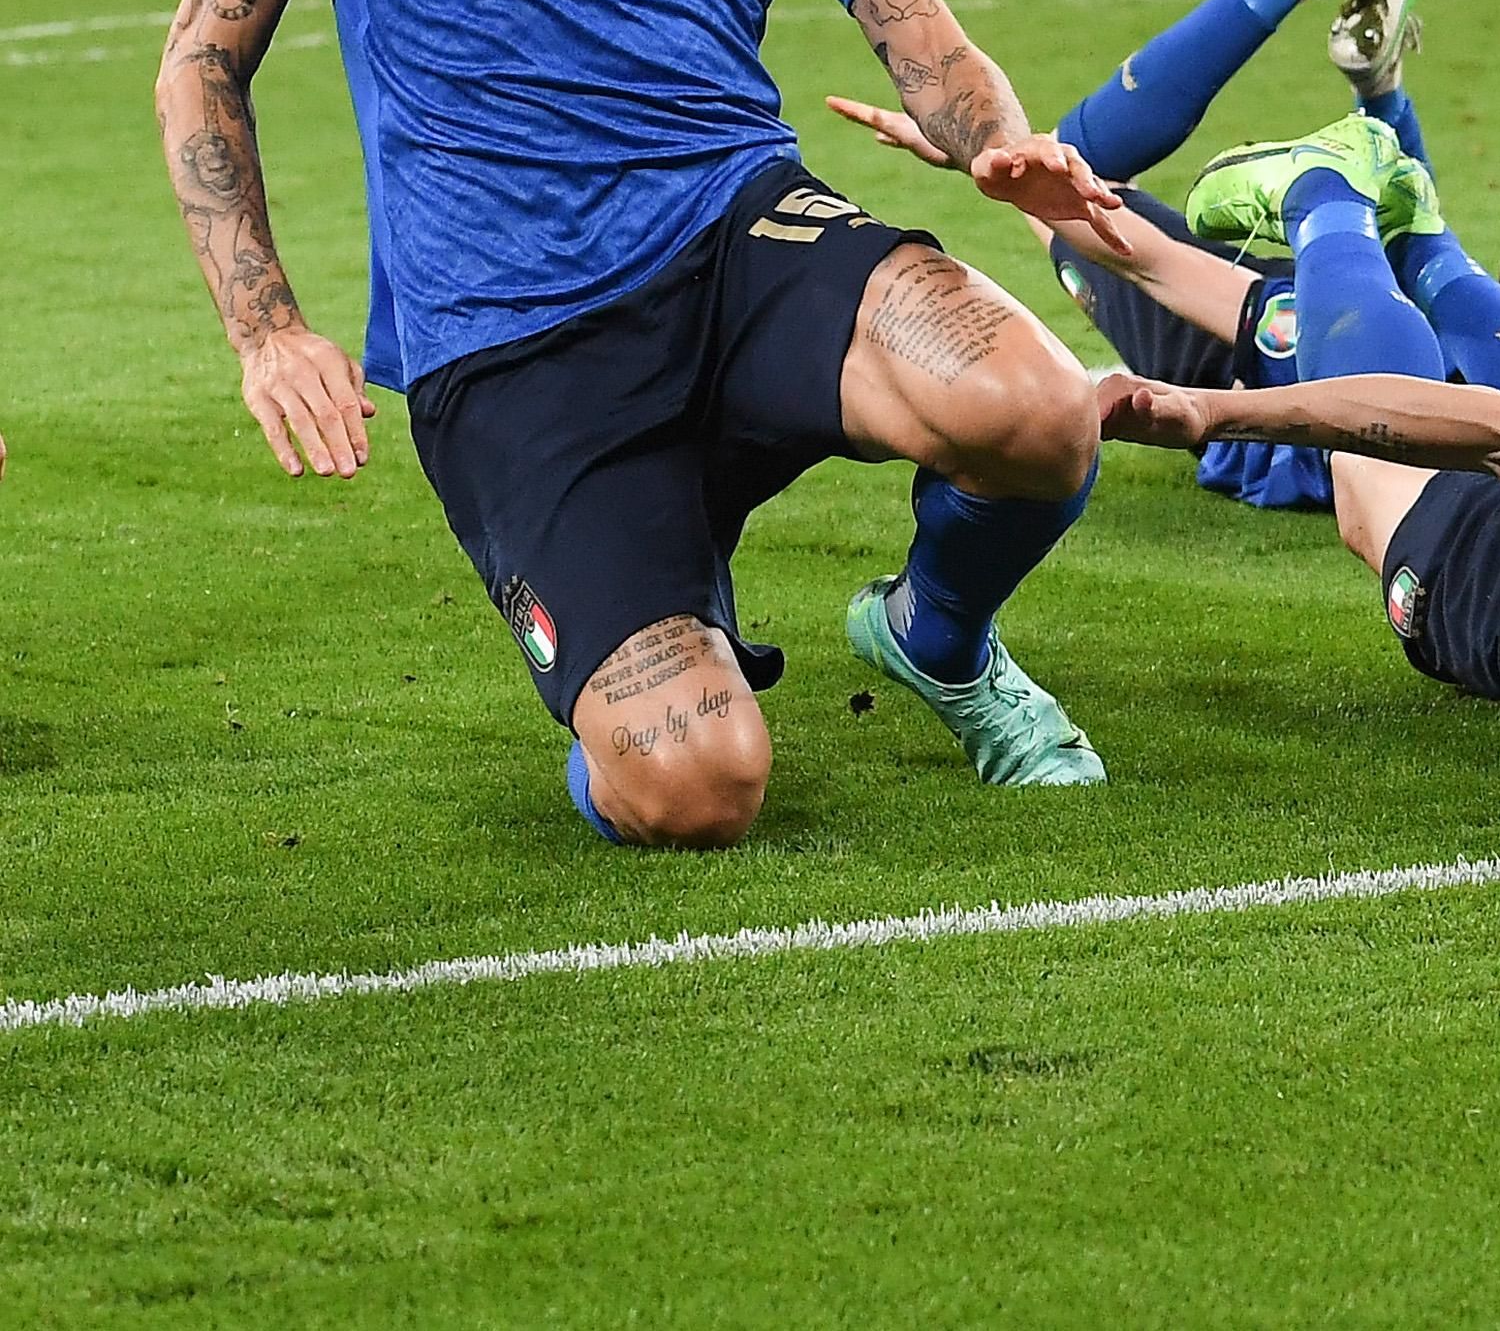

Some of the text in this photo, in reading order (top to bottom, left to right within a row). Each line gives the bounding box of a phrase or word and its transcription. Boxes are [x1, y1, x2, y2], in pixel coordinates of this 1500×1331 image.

[747, 186, 861, 244] 15
[513, 589, 532, 634] ITALIA
[612, 687, 733, 757] Day by day
